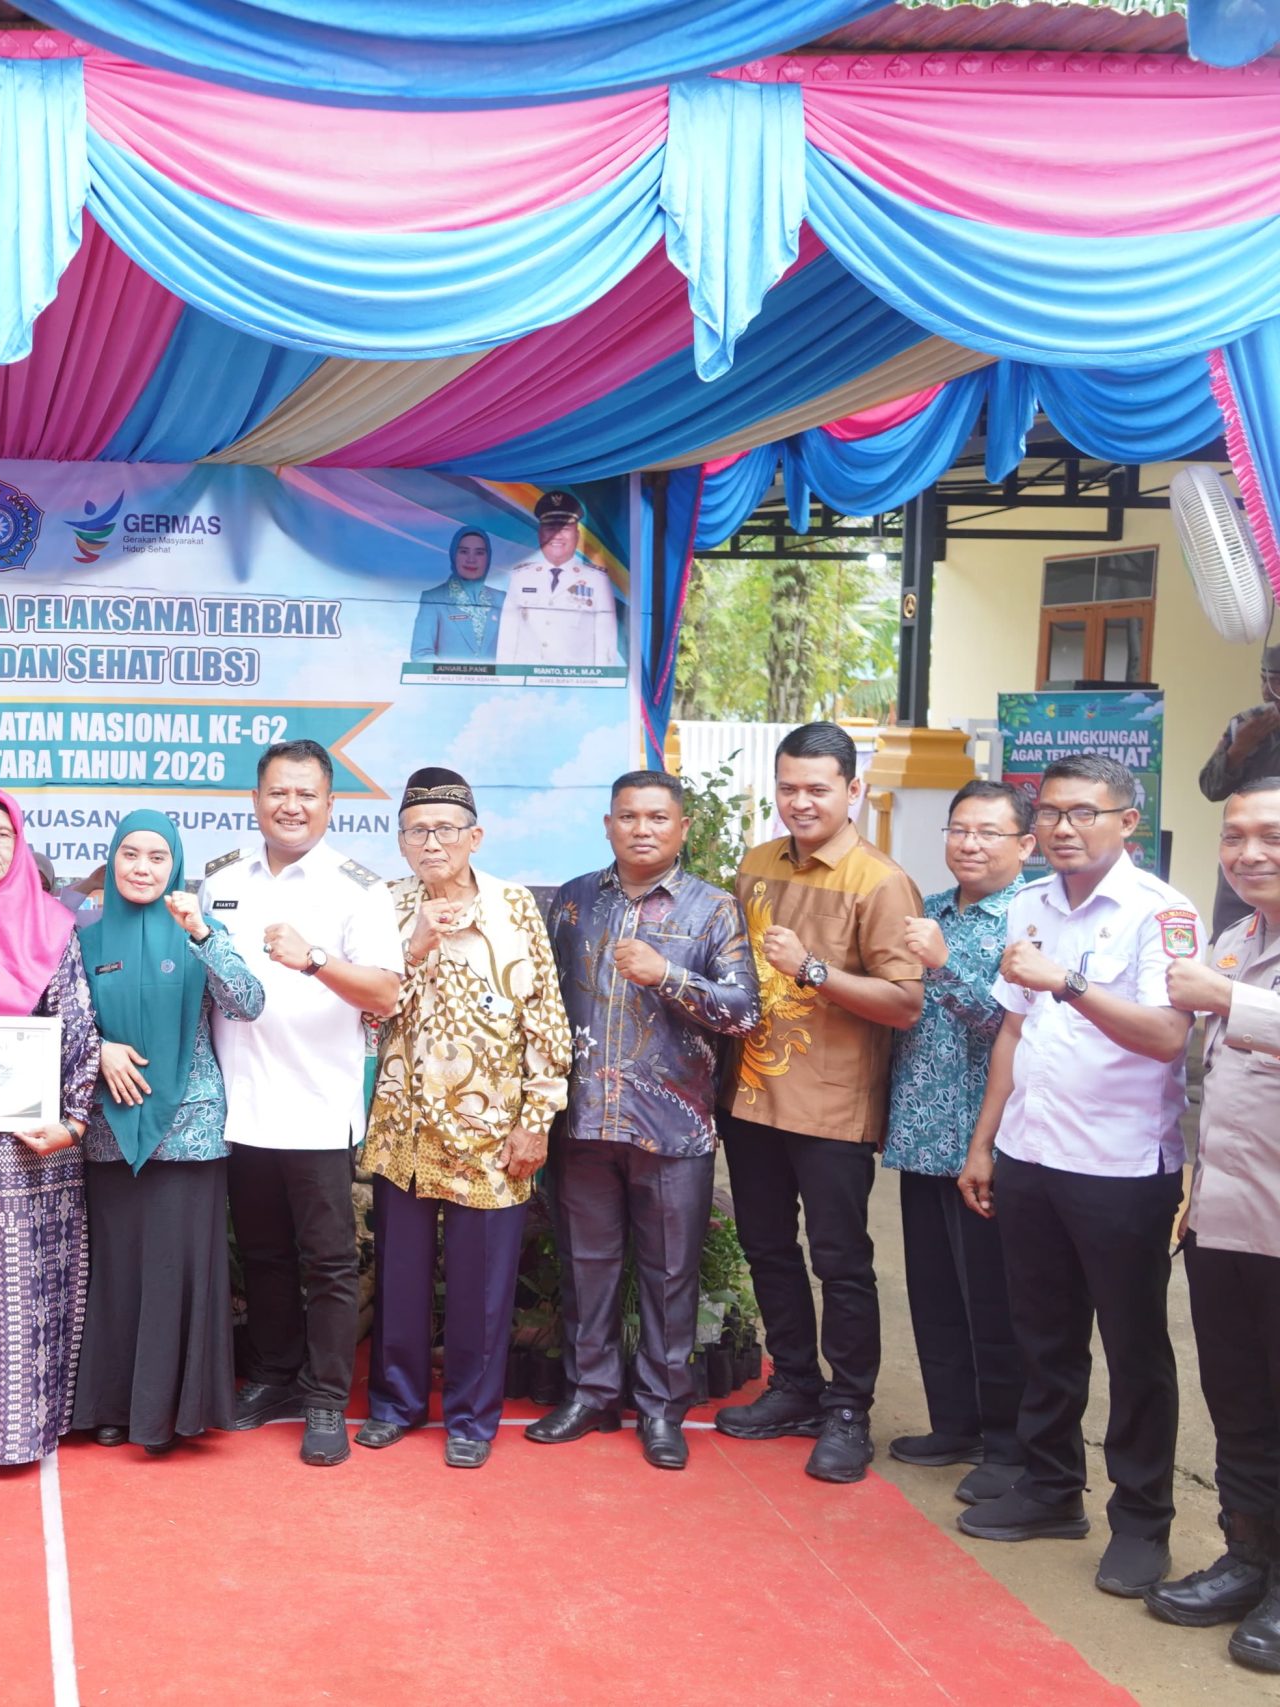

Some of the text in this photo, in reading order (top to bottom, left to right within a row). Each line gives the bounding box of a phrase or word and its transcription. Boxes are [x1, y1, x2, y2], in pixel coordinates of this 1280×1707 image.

[123, 513, 222, 535] GERMAS
[122, 535, 204, 546] Gerakan Masyarakat
[122, 545, 171, 554] Hidup Sehat
[14, 597, 199, 635] PELAKSANA
[202, 600, 340, 637] TERBAIK
[65, 646, 168, 683] SEHAT
[171, 648, 258, 686] (LBS)
[70, 711, 203, 744] NASIONAL
[208, 714, 288, 745] KE-62
[1015, 730, 1149, 745] JAGA LINGKUNGAN
[1010, 749, 1043, 762] AGAR
[57, 750, 148, 781] TAHUN
[152, 750, 226, 782] 2026
[327, 814, 389, 833] AHAN
[45, 842, 109, 861] UTAR
